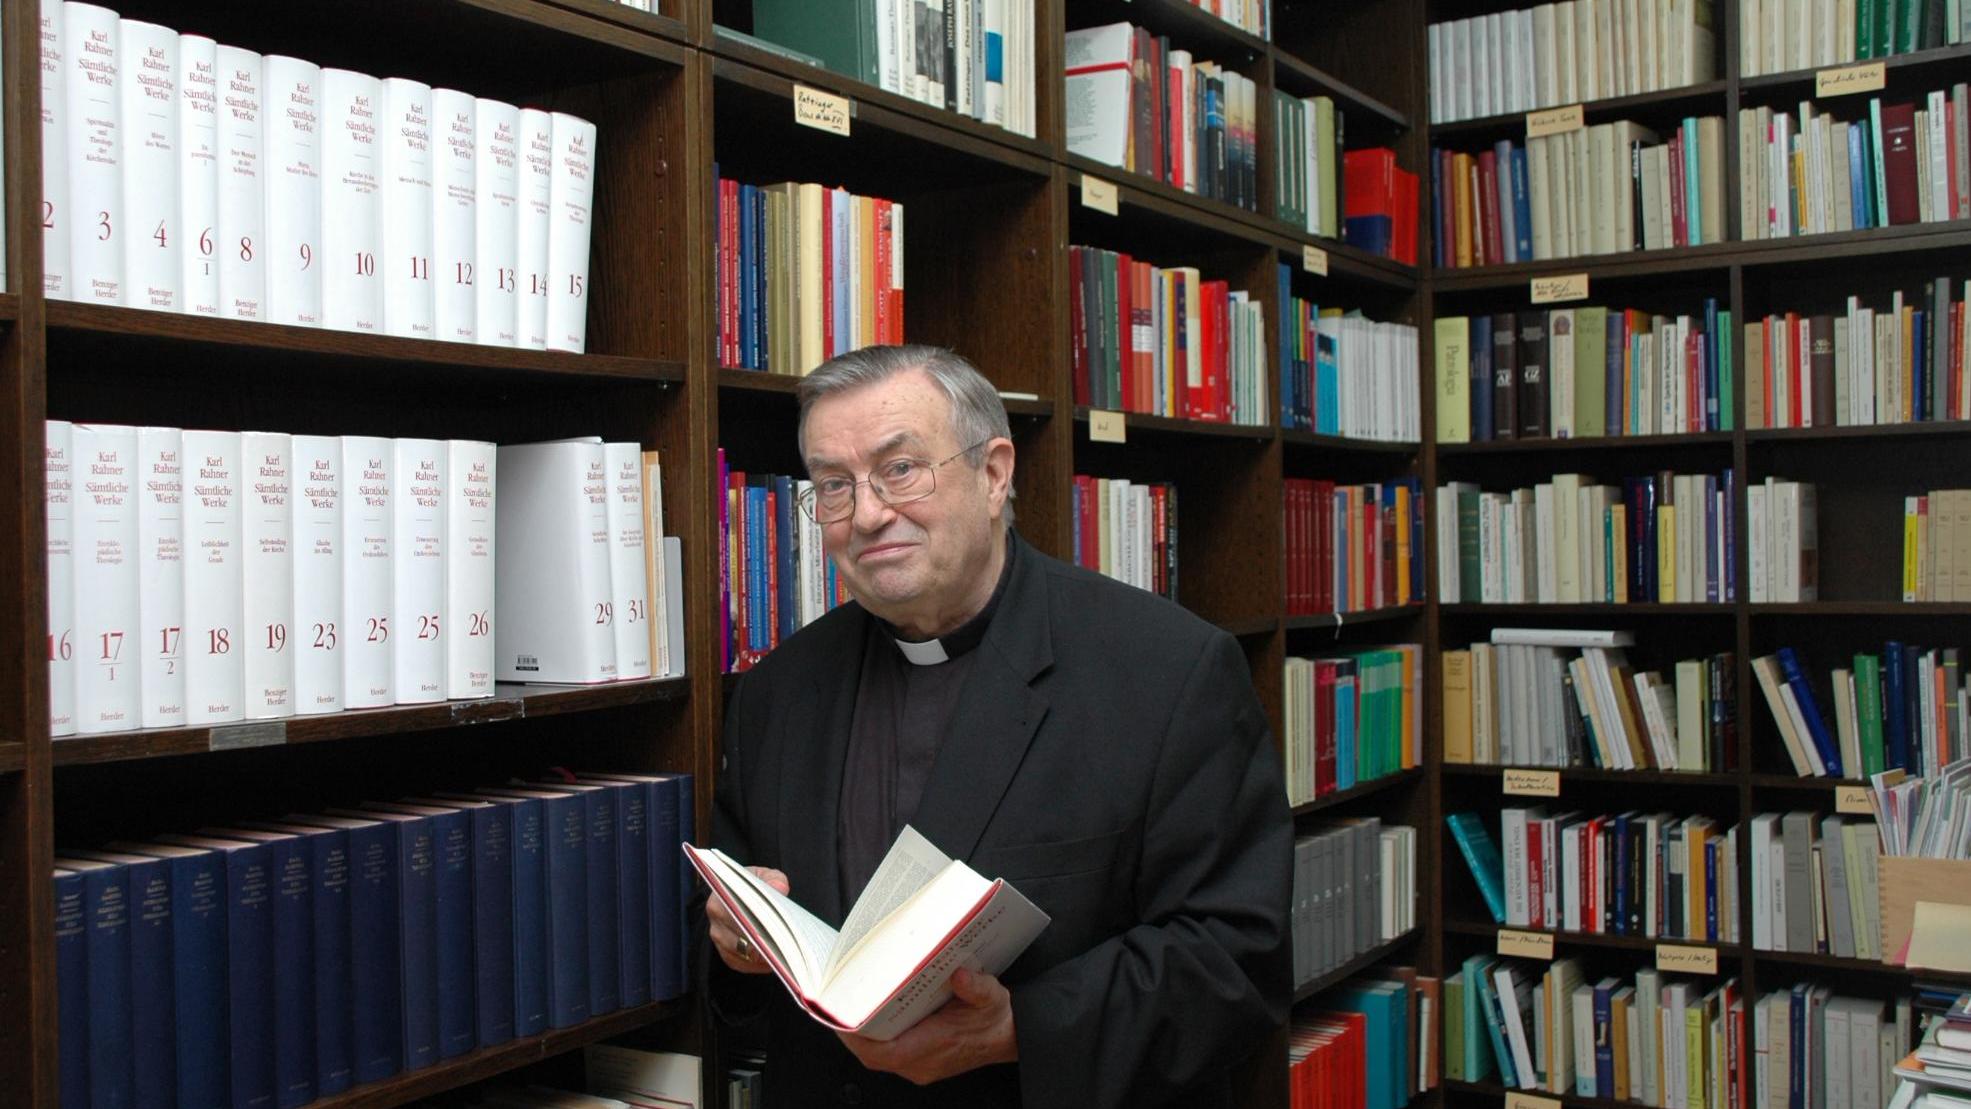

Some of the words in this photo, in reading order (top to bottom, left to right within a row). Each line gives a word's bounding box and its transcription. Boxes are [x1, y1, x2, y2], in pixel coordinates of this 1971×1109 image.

[92, 30, 108, 42] Karl
[84, 42, 113, 56] Rahner
[149, 47, 165, 59] Karl
[79, 58, 118, 74] Sämtliche
[142, 58, 170, 72] Rahner
[196, 61, 212, 73] Karl
[86, 72, 112, 86] Werke
[138, 74, 174, 90] Sämtliche
[189, 72, 216, 86] Rahner
[236, 70, 250, 82] Karl
[144, 87, 170, 100] Werke
[230, 81, 256, 94] Rahner
[296, 83, 310, 94] Karl
[225, 96, 260, 112] Sämtliche
[292, 92, 315, 106] Rahner
[356, 96, 368, 106] Karl
[192, 100, 215, 114] Werke
[350, 105, 373, 119] Rahner
[410, 104, 423, 115] Karl
[232, 108, 255, 122] Werke
[286, 108, 317, 124] Sämtliche
[406, 113, 427, 126] Rahner
[457, 114, 469, 124] Karl
[293, 120, 313, 133] Werke
[346, 120, 376, 136] Sämtliche
[452, 122, 472, 136] Rahner
[352, 132, 372, 144] Werke
[401, 128, 429, 142] Sämtliche
[407, 140, 426, 152] Werke
[454, 148, 472, 160] Werke
[98, 211, 111, 240] 3
[154, 219, 167, 248] 4
[200, 227, 212, 256] 6
[240, 236, 252, 262] 8
[300, 243, 311, 271] 9
[204, 262, 209, 276] 1
[356, 252, 374, 276] 10
[411, 256, 428, 280] 11
[456, 262, 472, 286] 12
[498, 268, 514, 293] 13
[531, 272, 548, 296] 14
[569, 274, 582, 298] 15
[100, 452, 117, 462] Karl
[160, 451, 176, 462] Karl
[206, 456, 222, 467] Karl
[266, 456, 280, 466] Karl
[92, 464, 124, 475] Rahner
[154, 463, 180, 474] Rahner
[316, 460, 330, 470] Karl
[369, 459, 382, 469] Karl
[420, 460, 434, 470] Karl
[472, 462, 485, 472] Karl
[200, 468, 228, 480] Rahner
[260, 467, 285, 478] Rahner
[310, 471, 335, 482] Rahner
[364, 470, 386, 480] Rahner
[416, 472, 438, 481] Rahner
[468, 473, 488, 483] Rahner
[86, 482, 128, 494] Sämtliche
[194, 486, 232, 496] Sämtliche
[255, 484, 288, 494] Sämtliche
[304, 488, 338, 498] Sämtliche
[359, 486, 388, 496] Sämtliche
[410, 486, 442, 497] Sämtliche
[464, 488, 492, 498] Sämtliche
[94, 494, 123, 506] Werke
[156, 493, 180, 504] Werke
[202, 498, 228, 508] Werke
[262, 496, 284, 506] Werke
[311, 499, 334, 509] Werke
[366, 498, 386, 508] Werke
[416, 498, 438, 508] Werke
[469, 498, 488, 508] Werke
[596, 602, 614, 628] 29
[628, 599, 645, 623] 31
[418, 615, 438, 640] 25
[470, 610, 488, 636] 26
[313, 622, 336, 650] 23
[367, 617, 388, 644] 25
[160, 628, 180, 656] 17
[208, 628, 230, 654] 18
[266, 624, 286, 652] 19
[100, 632, 124, 660] 17
[109, 667, 114, 681] 1
[168, 661, 174, 674] 2
